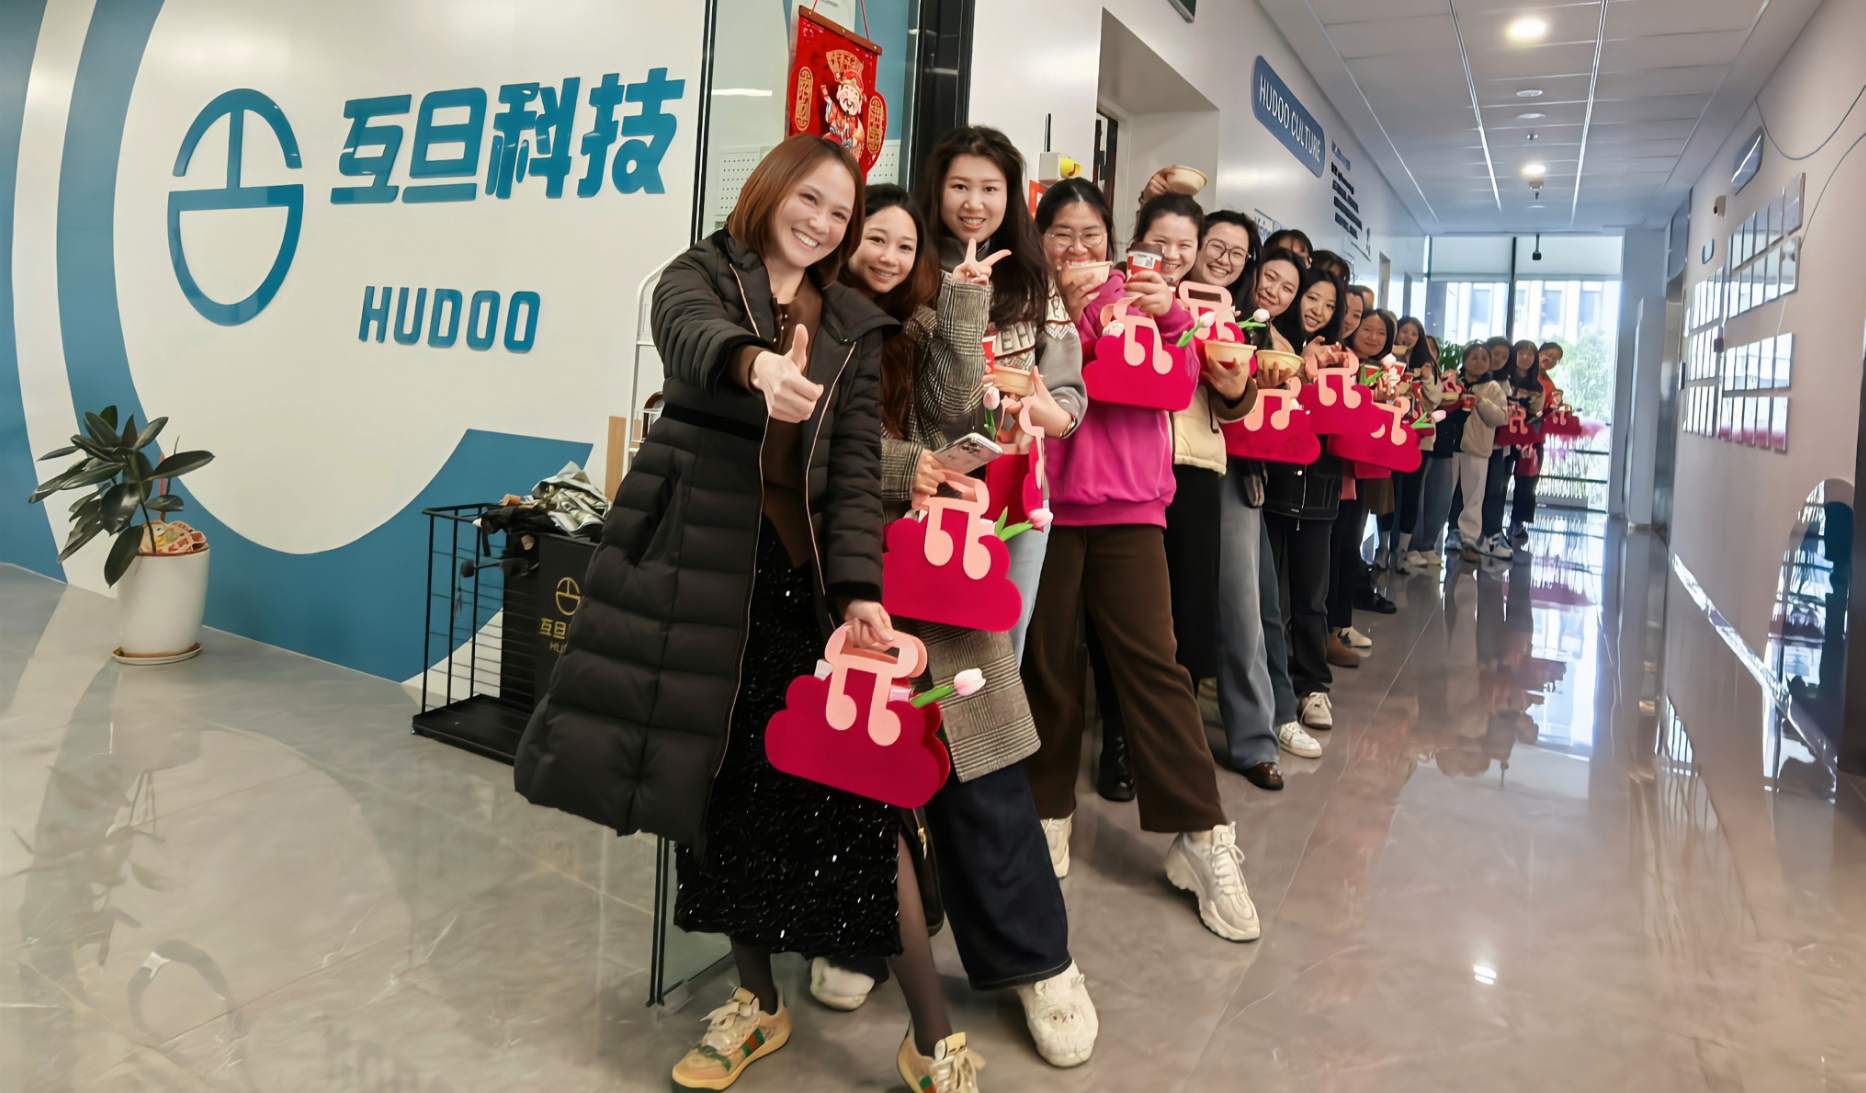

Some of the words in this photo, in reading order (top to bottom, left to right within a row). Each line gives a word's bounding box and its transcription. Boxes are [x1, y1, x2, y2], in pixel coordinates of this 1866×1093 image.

[330, 67, 686, 205] 互旦科技
[1259, 74, 1290, 129] HUDOO
[1291, 110, 1321, 162] CULTURE
[358, 285, 541, 354] HUDOO
